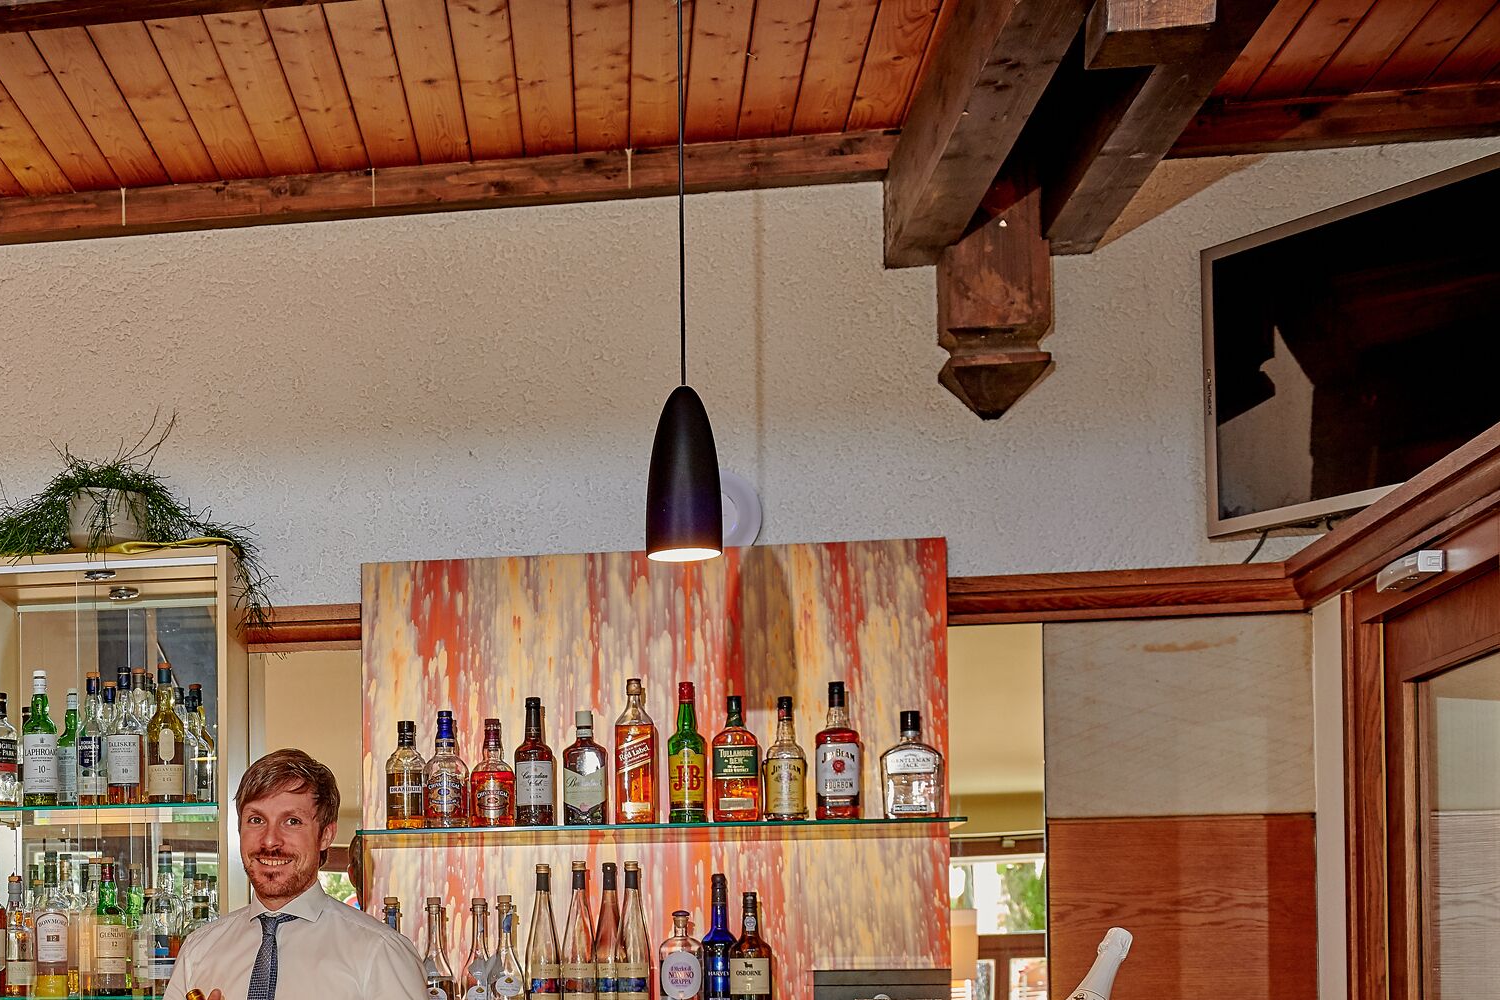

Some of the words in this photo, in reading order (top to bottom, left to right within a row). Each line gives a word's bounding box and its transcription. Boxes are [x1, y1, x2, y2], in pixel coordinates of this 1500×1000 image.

[835, 748, 855, 763] BEAM
[38, 765, 46, 774] 10
[824, 781, 854, 789] BOURBON
